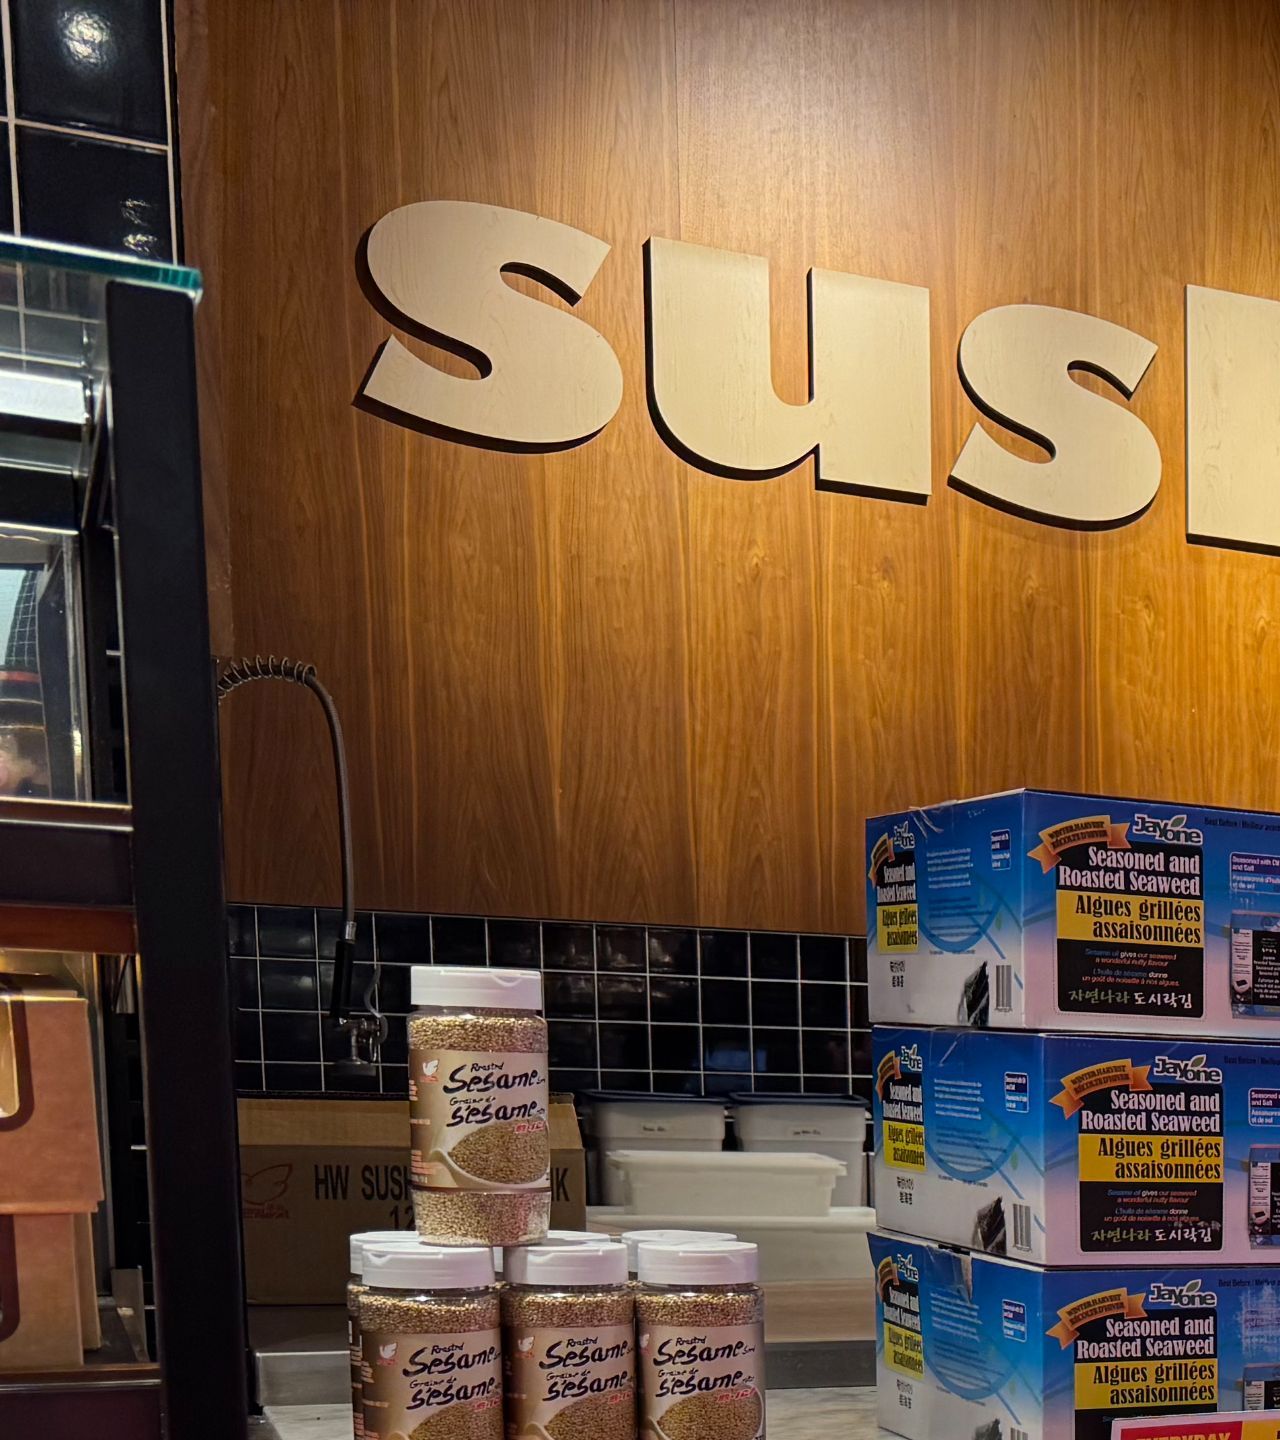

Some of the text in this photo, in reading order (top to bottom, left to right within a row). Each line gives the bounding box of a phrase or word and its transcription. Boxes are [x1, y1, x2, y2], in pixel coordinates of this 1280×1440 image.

[1088, 847, 1200, 874] Seasoned and
[1059, 866, 1200, 896] Roasted Seaweed
[1075, 894, 1200, 922] Algues grillées
[1092, 920, 1200, 945] assaisonnées
[443, 1064, 538, 1094] Sesame
[314, 1164, 349, 1200] HW
[403, 1347, 495, 1377] Sesame
[539, 1340, 627, 1369] Sesame
